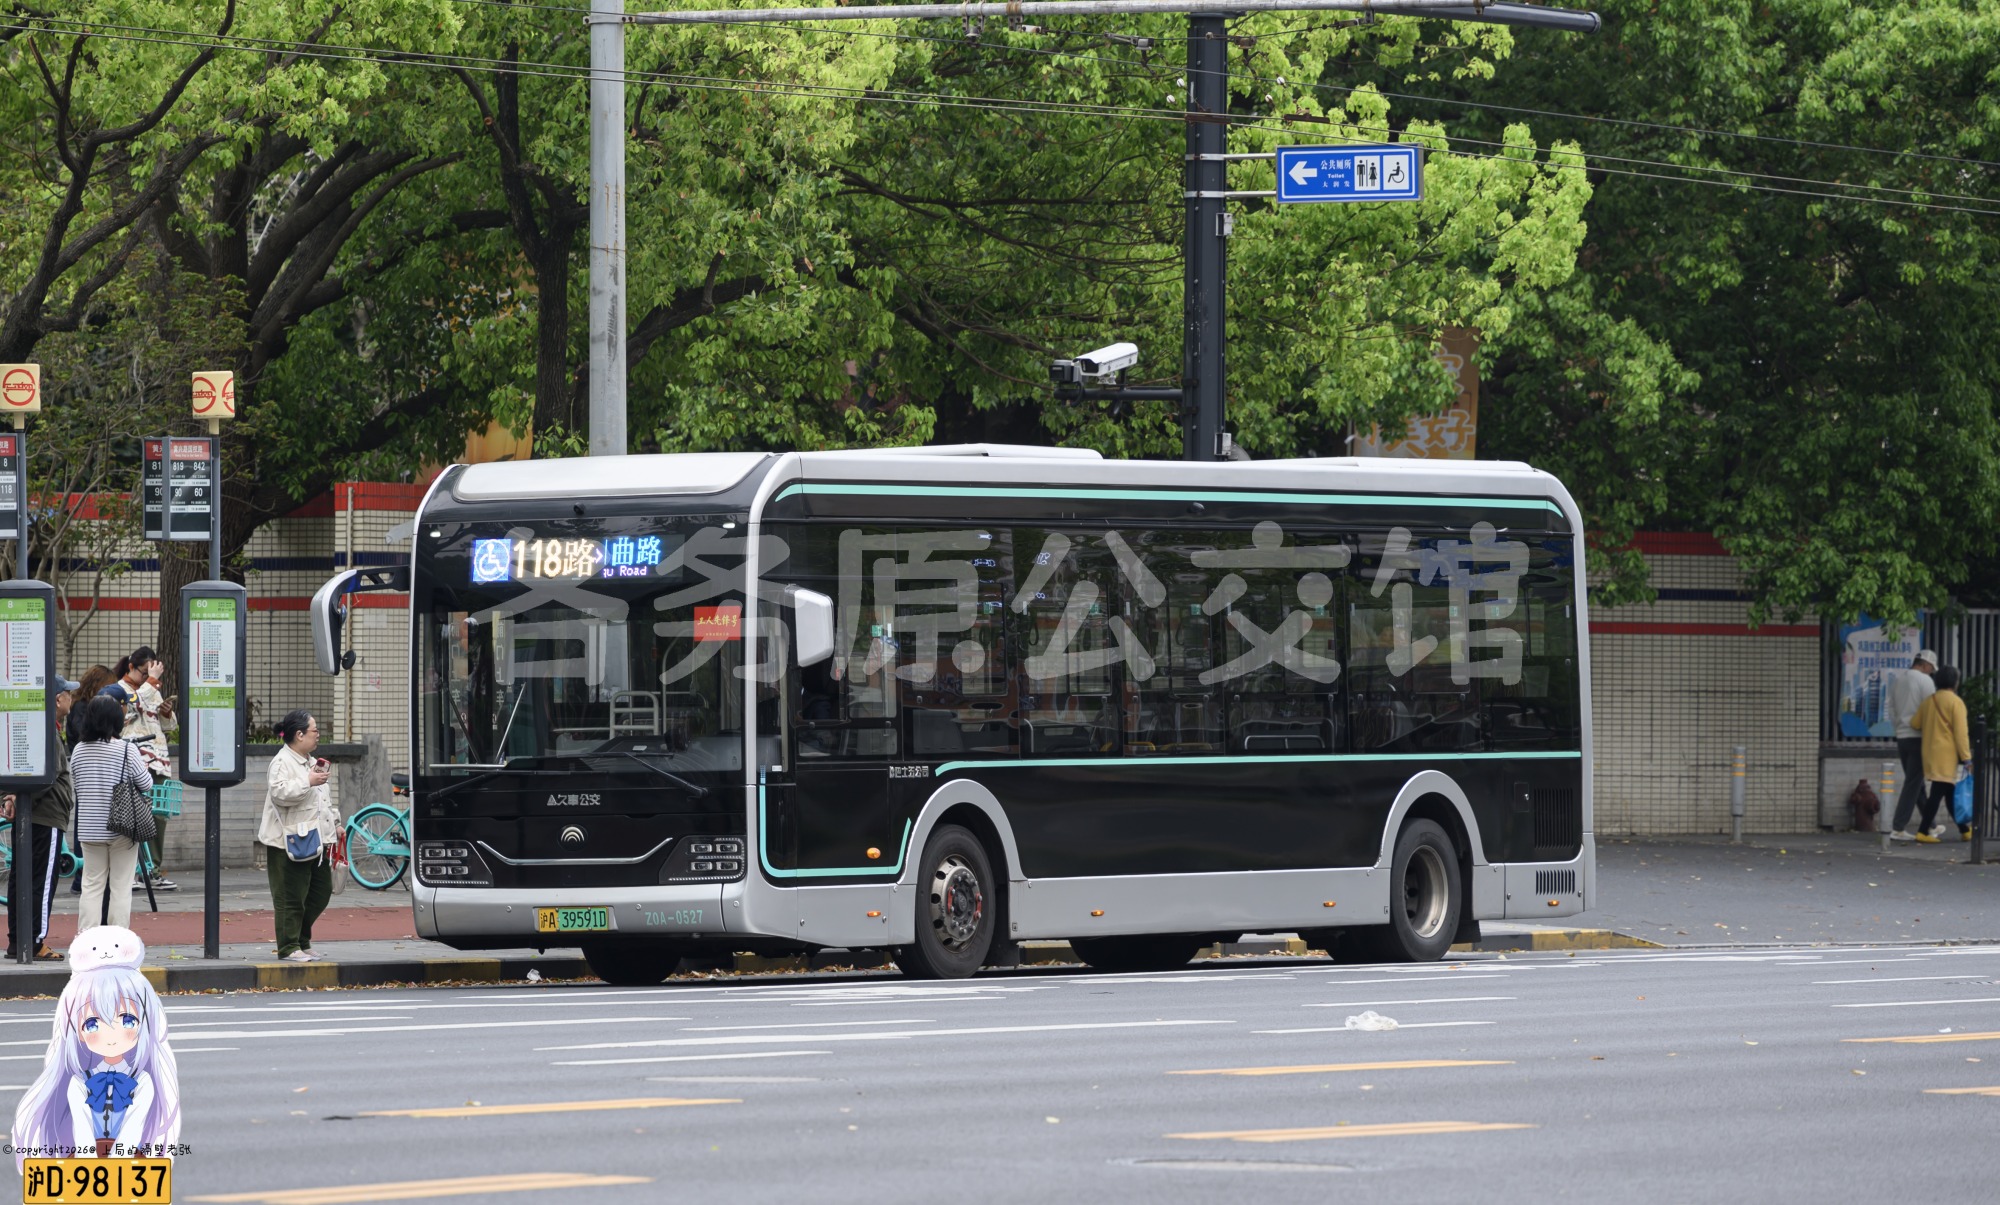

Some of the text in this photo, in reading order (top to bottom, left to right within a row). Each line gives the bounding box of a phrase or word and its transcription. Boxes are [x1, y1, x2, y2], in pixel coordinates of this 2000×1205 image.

[1320, 158, 1352, 170] 公共厕所
[3, 457, 8, 467] 8
[172, 461, 206, 471] 819 842
[174, 487, 203, 497] 90 60
[513, 536, 662, 578] 118路 曲路
[619, 565, 648, 577] Road
[7, 600, 14, 609] 8
[196, 600, 208, 608] 60
[697, 614, 738, 628] 工人先锋号
[4, 690, 20, 699] 118
[193, 688, 210, 696] 819
[557, 793, 601, 806] 久事公交
